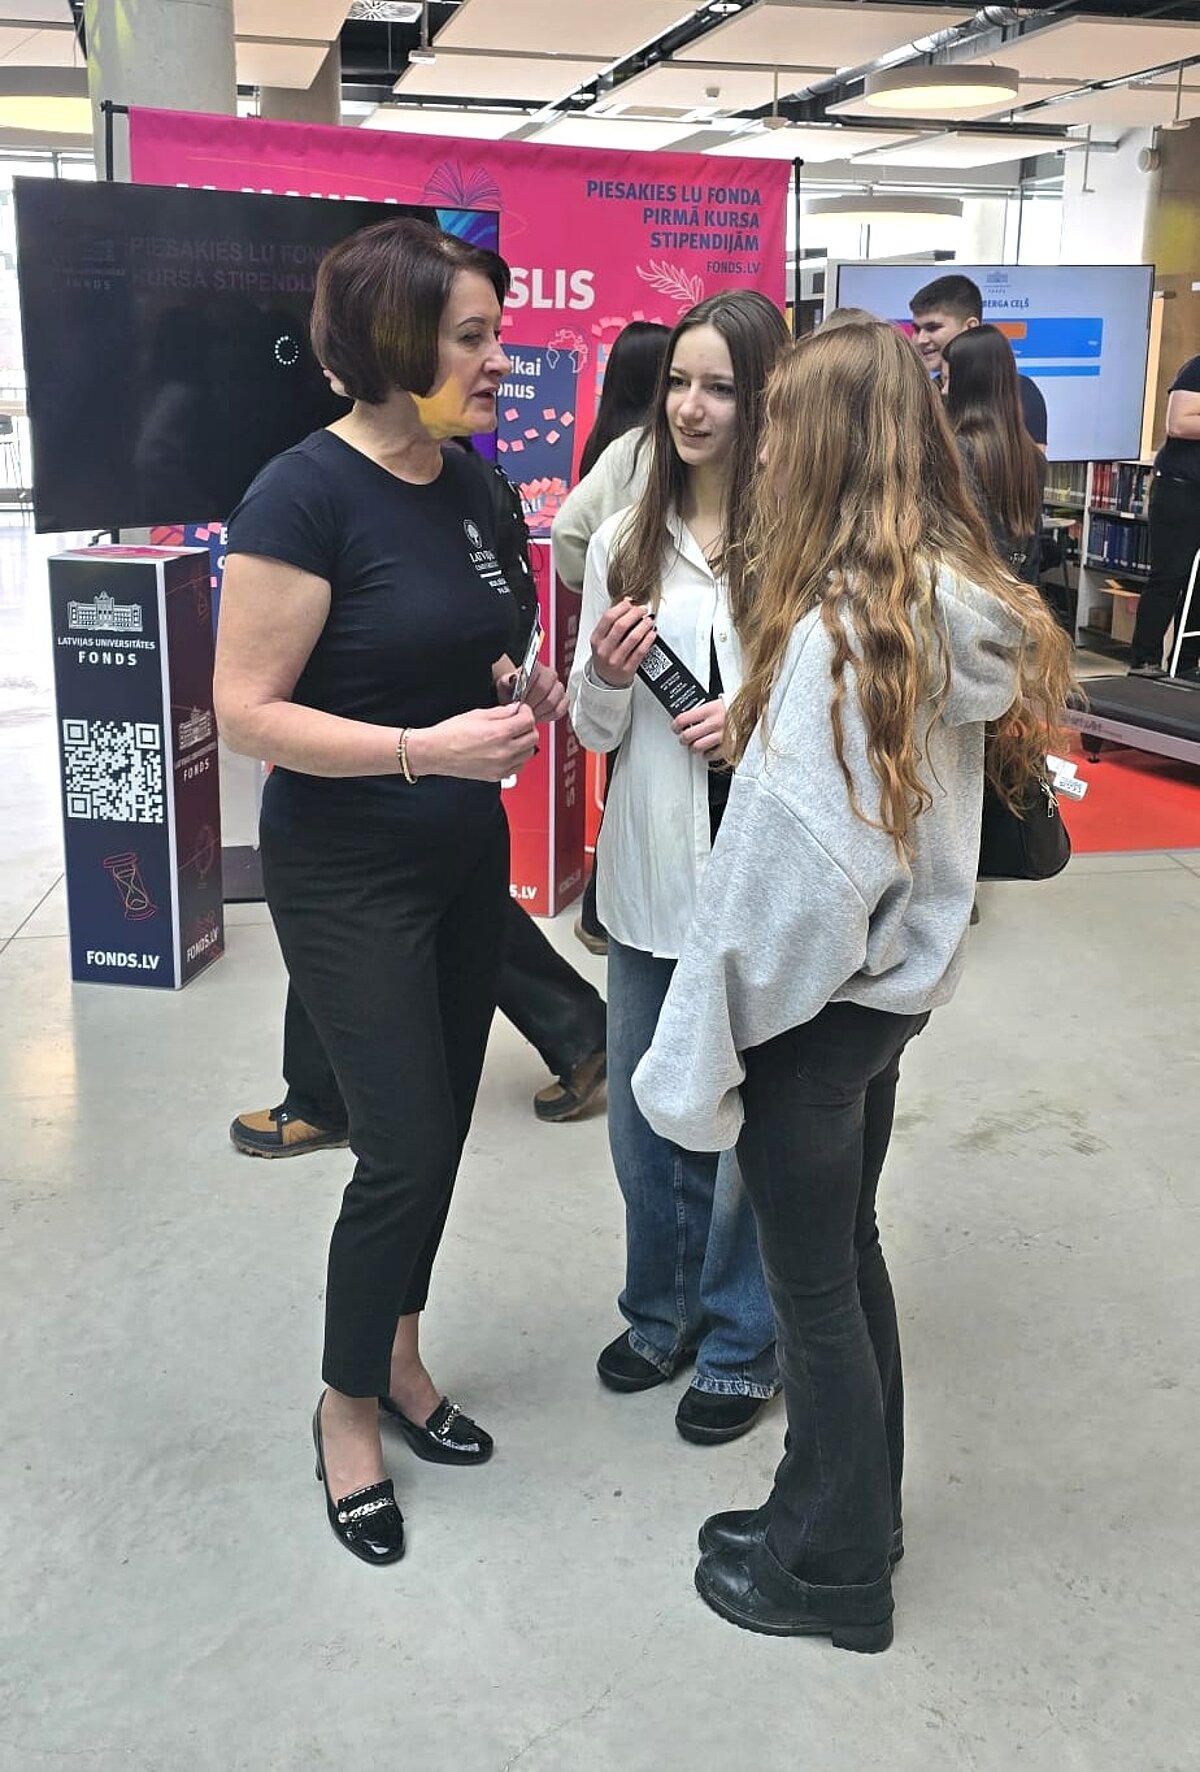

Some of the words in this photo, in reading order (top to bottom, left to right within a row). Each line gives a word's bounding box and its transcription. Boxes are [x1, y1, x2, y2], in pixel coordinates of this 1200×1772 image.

[587, 180, 676, 201] PIESAKIES
[682, 184, 702, 203] LU
[708, 187, 761, 206] FONDA
[643, 206, 700, 226] PIRMĀ
[704, 211, 760, 228] KURSA
[651, 231, 759, 253] STIPENDIJĀM
[707, 261, 760, 274] FONDS.LV
[510, 355, 541, 376] ikai
[58, 637, 94, 648] LATVIJAS
[79, 651, 137, 666] FONDS
[184, 758, 209, 782] FONDS
[187, 927, 219, 962] FONDS.LV
[86, 950, 160, 970] FONDS.LV
